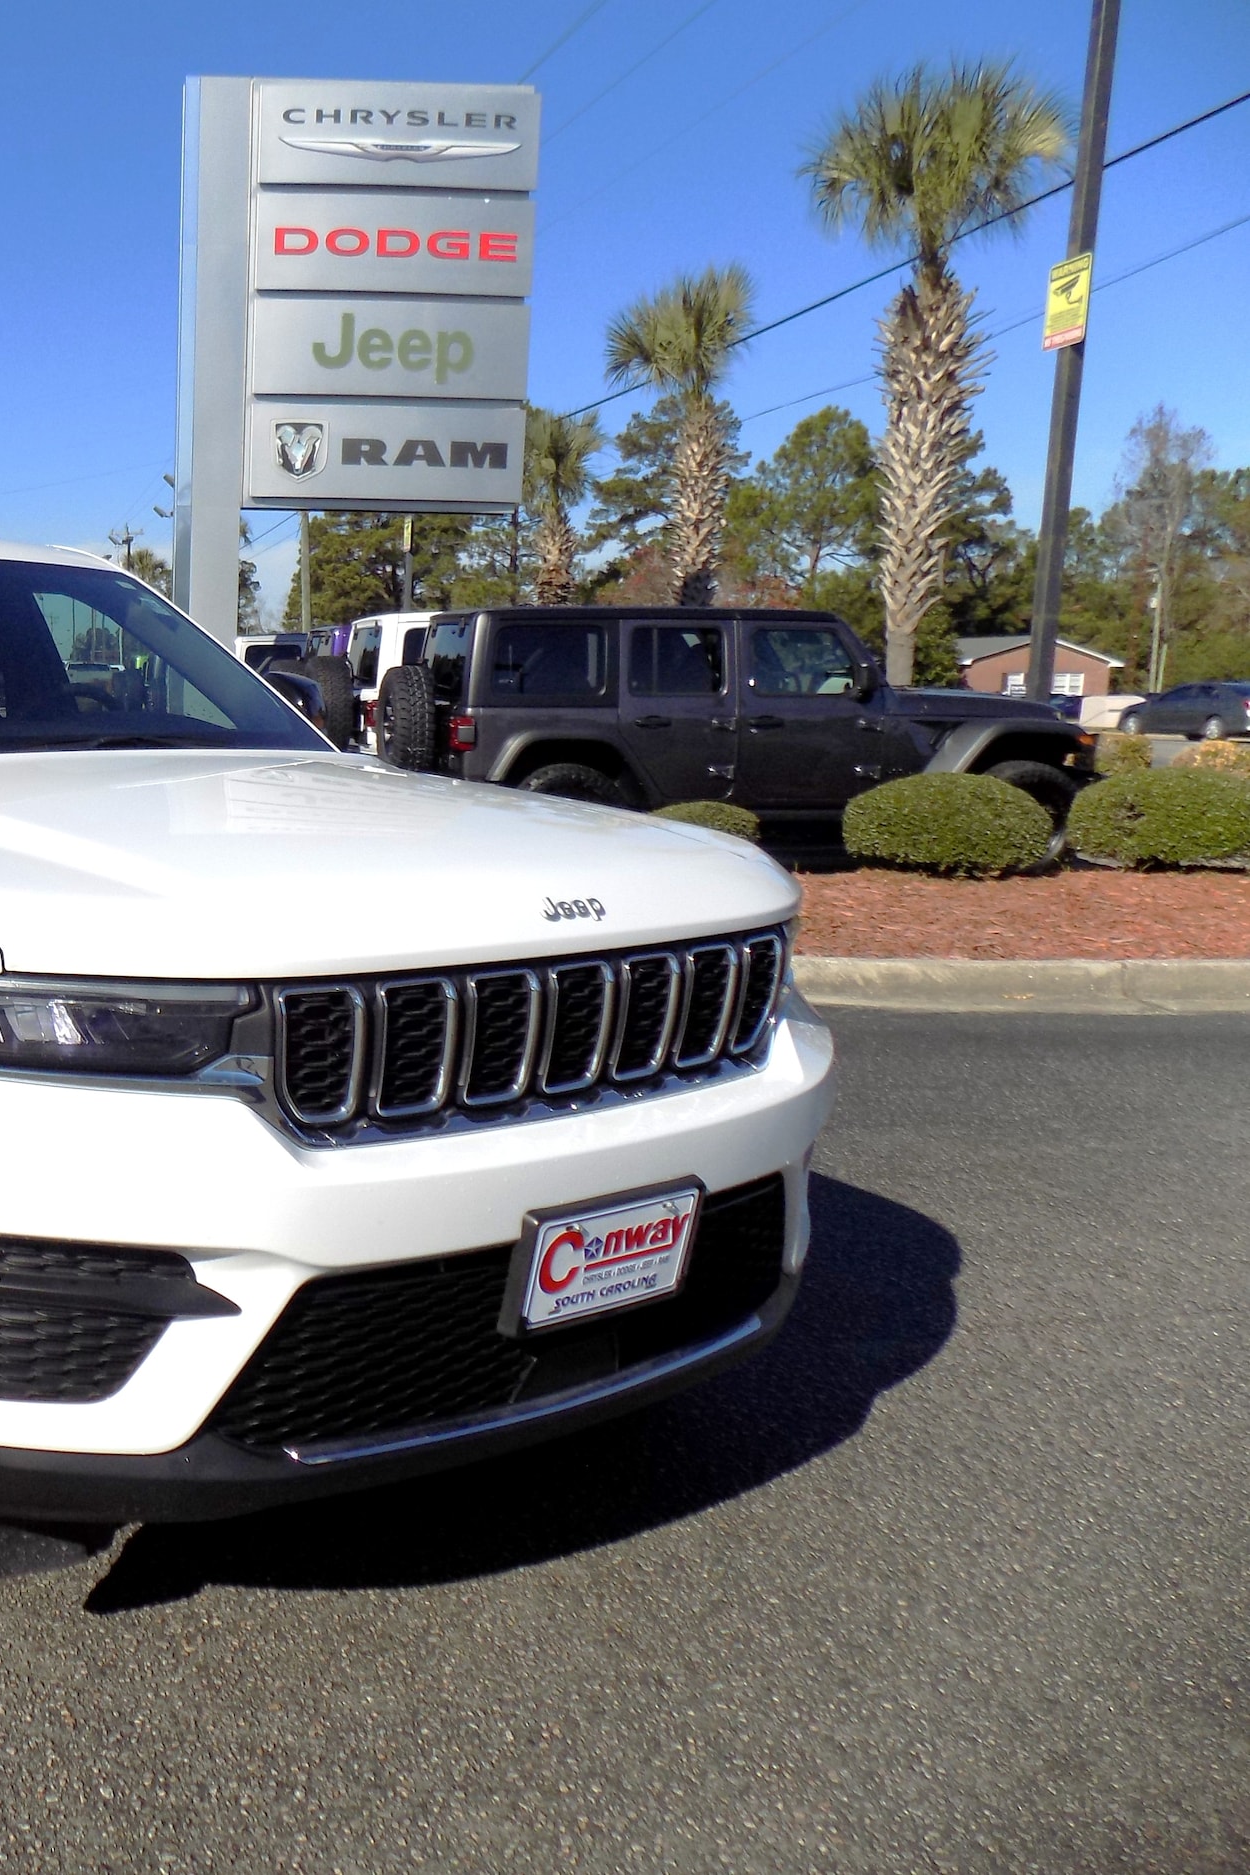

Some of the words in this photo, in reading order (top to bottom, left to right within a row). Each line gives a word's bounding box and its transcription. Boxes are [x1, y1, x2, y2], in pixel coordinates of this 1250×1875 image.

[282, 108, 518, 131] CHRYSLER
[273, 227, 519, 263] DODGE
[312, 312, 474, 385] Jeep
[341, 437, 509, 470] RAM
[539, 897, 606, 922] Jeep
[553, 1289, 596, 1310] SOUTH
[599, 1273, 658, 1298] CAROLINA
